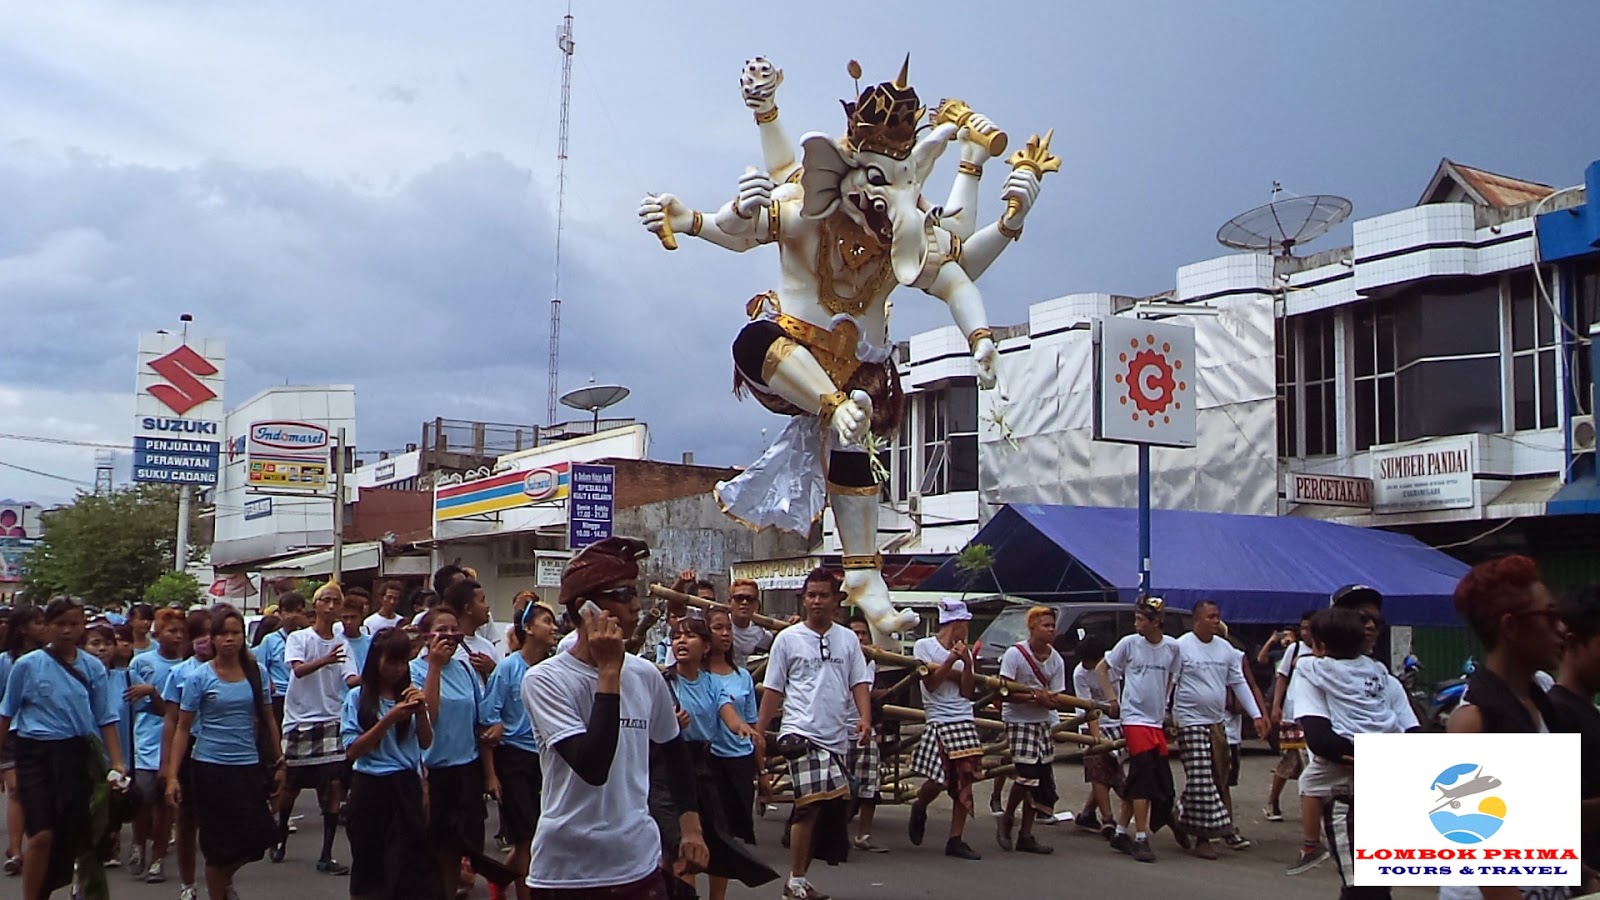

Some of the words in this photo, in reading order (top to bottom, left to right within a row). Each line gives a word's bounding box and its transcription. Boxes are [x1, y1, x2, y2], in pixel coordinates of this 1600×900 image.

[142, 417, 217, 435] SUZUKI
[254, 427, 324, 444] Indomaret
[146, 440, 211, 453] PENJUALAN
[146, 455, 210, 468] PERAWATAN
[1380, 454, 1425, 479] SUMBER
[1427, 449, 1468, 476] PANDAI
[138, 469, 167, 480] SUKU
[171, 471, 216, 483] CADANG
[1296, 476, 1370, 503] PERCETAKAN
